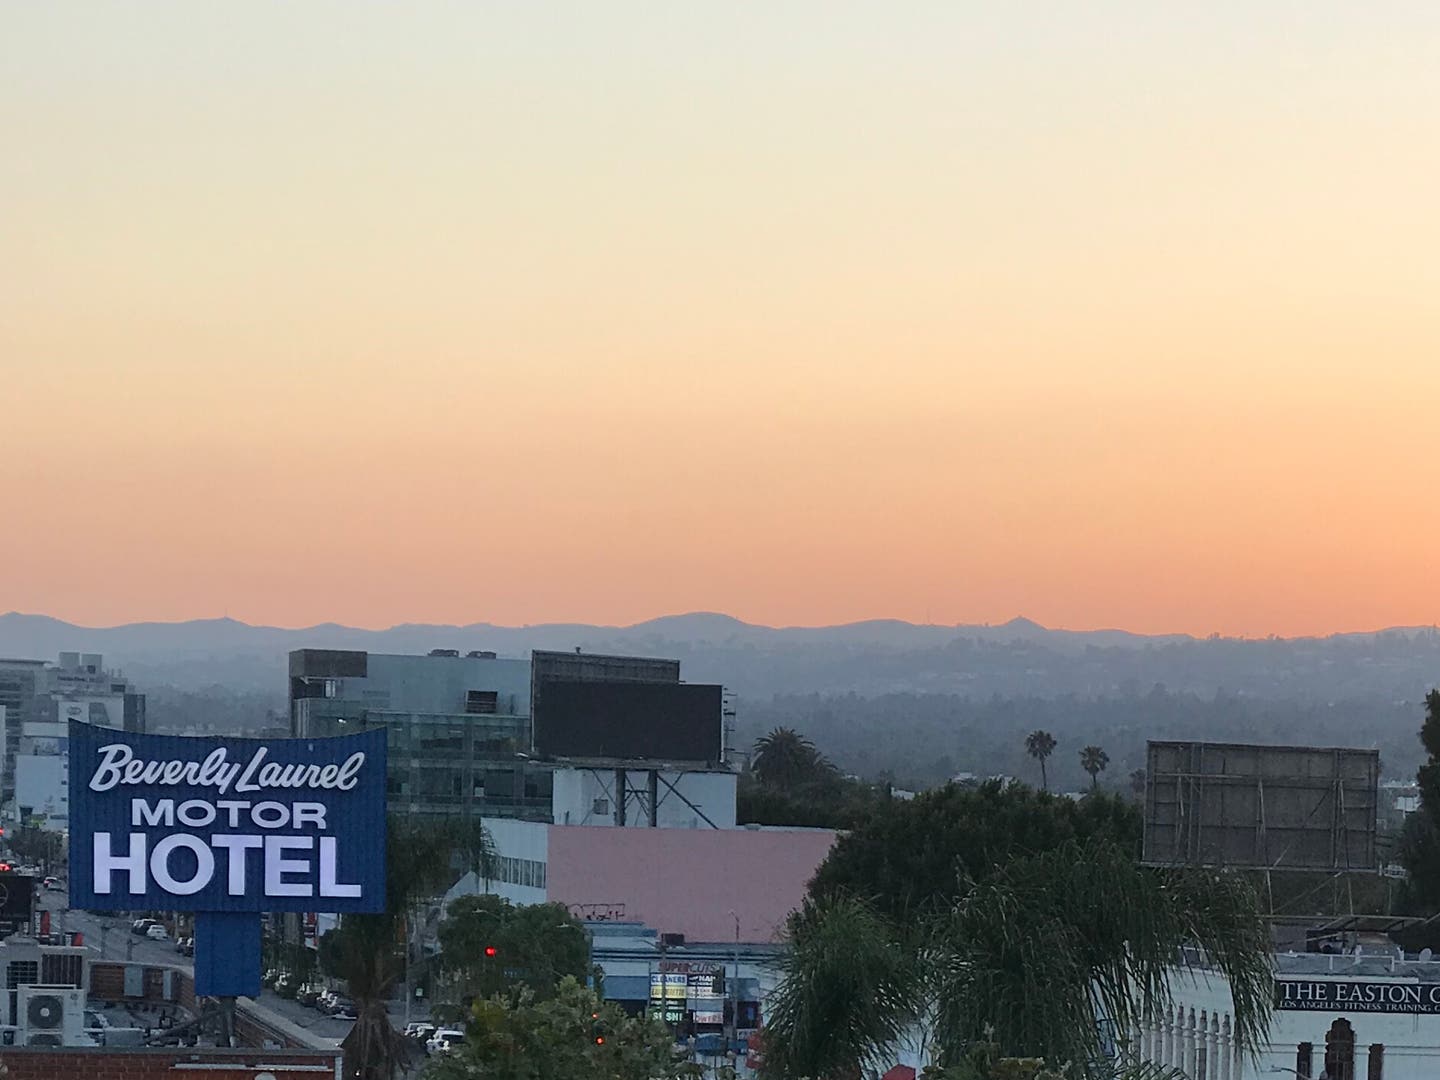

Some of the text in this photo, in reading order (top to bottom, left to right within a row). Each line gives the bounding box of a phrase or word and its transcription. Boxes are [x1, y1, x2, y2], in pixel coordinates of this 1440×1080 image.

[89, 744, 365, 794] Beverly Laurel
[132, 799, 326, 829] MOTOR
[93, 832, 362, 897] HOTEL
[1280, 982, 1327, 1000] THE
[1335, 984, 1422, 1003] EASTON
[1299, 1001, 1341, 1009] ANGELES
[1344, 1002, 1382, 1010] FITNESS
[1386, 1004, 1431, 1012] TRAINING
